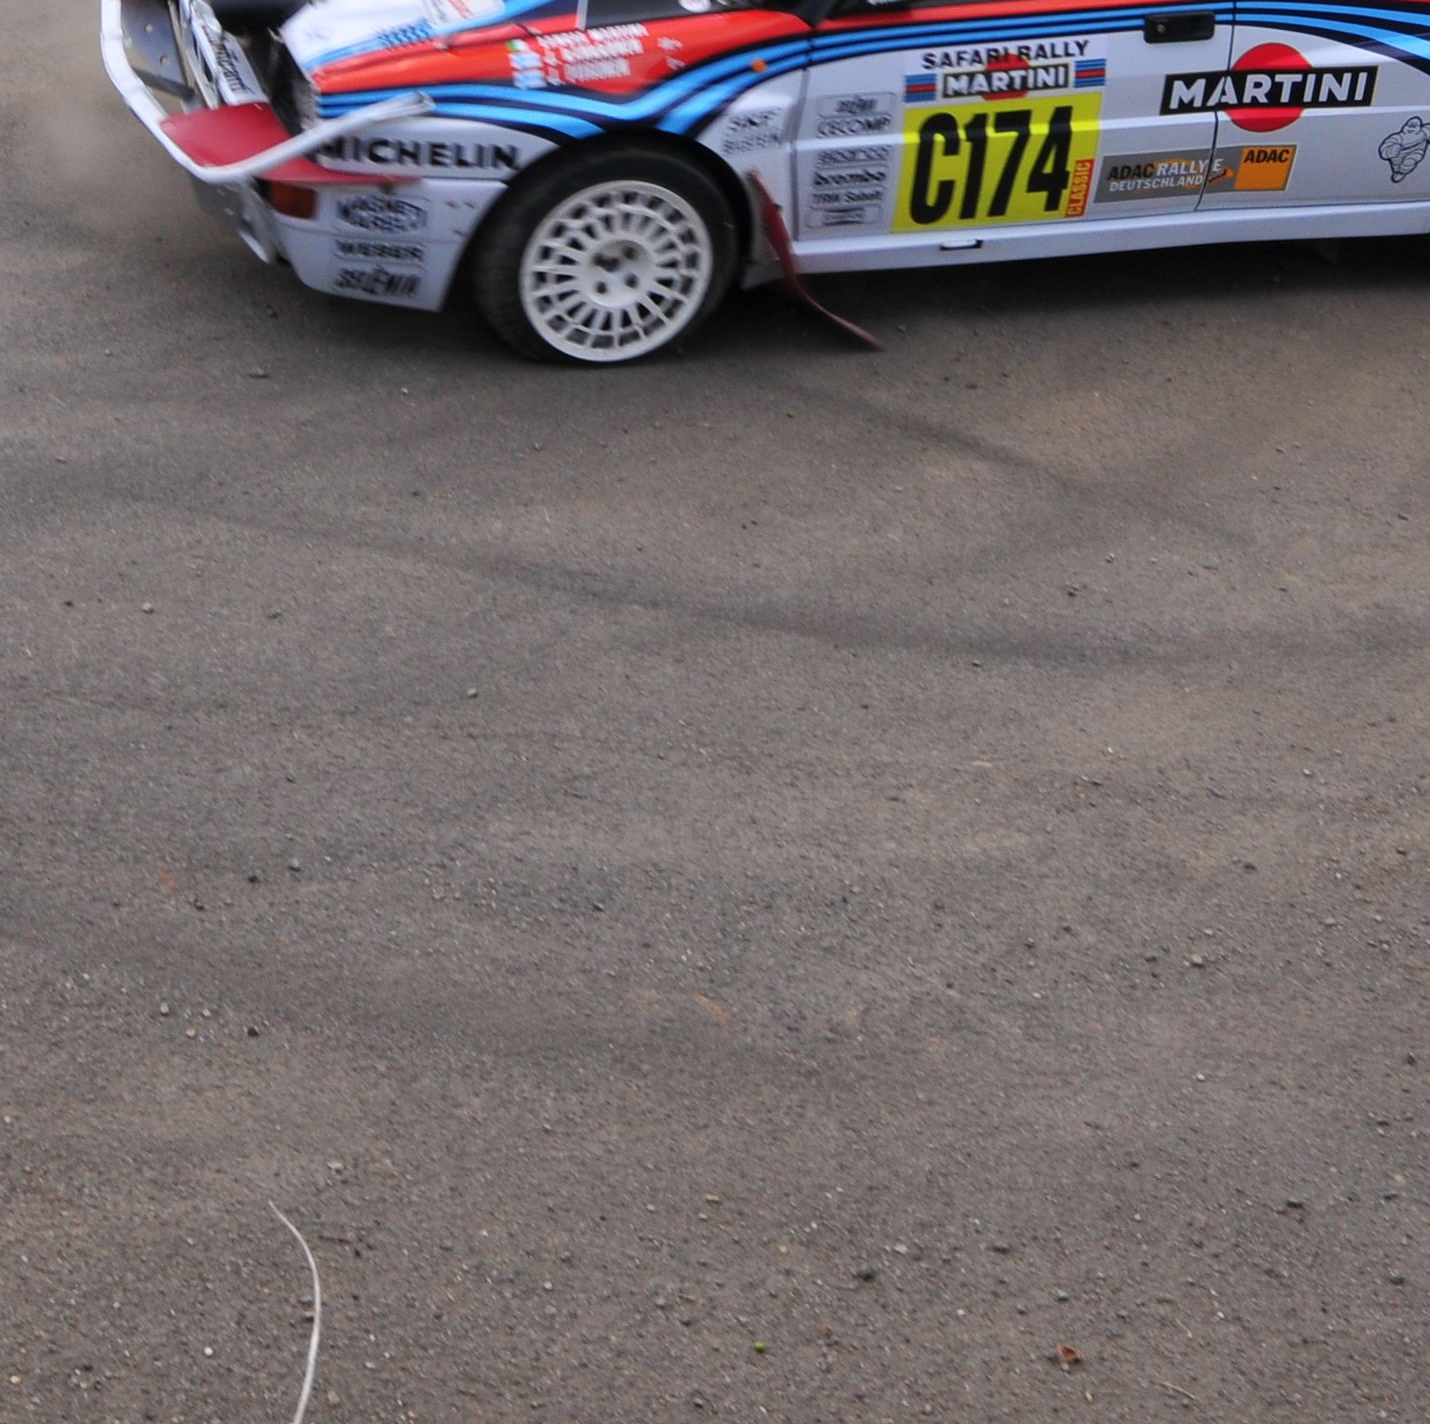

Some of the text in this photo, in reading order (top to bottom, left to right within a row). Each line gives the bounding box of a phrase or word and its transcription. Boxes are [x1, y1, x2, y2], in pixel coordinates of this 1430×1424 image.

[922, 39, 1089, 70] SAFARI RALLY
[946, 65, 1066, 97] MARTINI
[1169, 71, 1369, 110] MARTINI
[314, 135, 521, 169] MICHELIN
[909, 105, 1073, 225] C174
[1243, 148, 1291, 164] ADAC
[1067, 160, 1092, 216] CLASSIC
[1107, 163, 1155, 182] ADAC
[1109, 174, 1203, 192] DEUTSCHLAND
